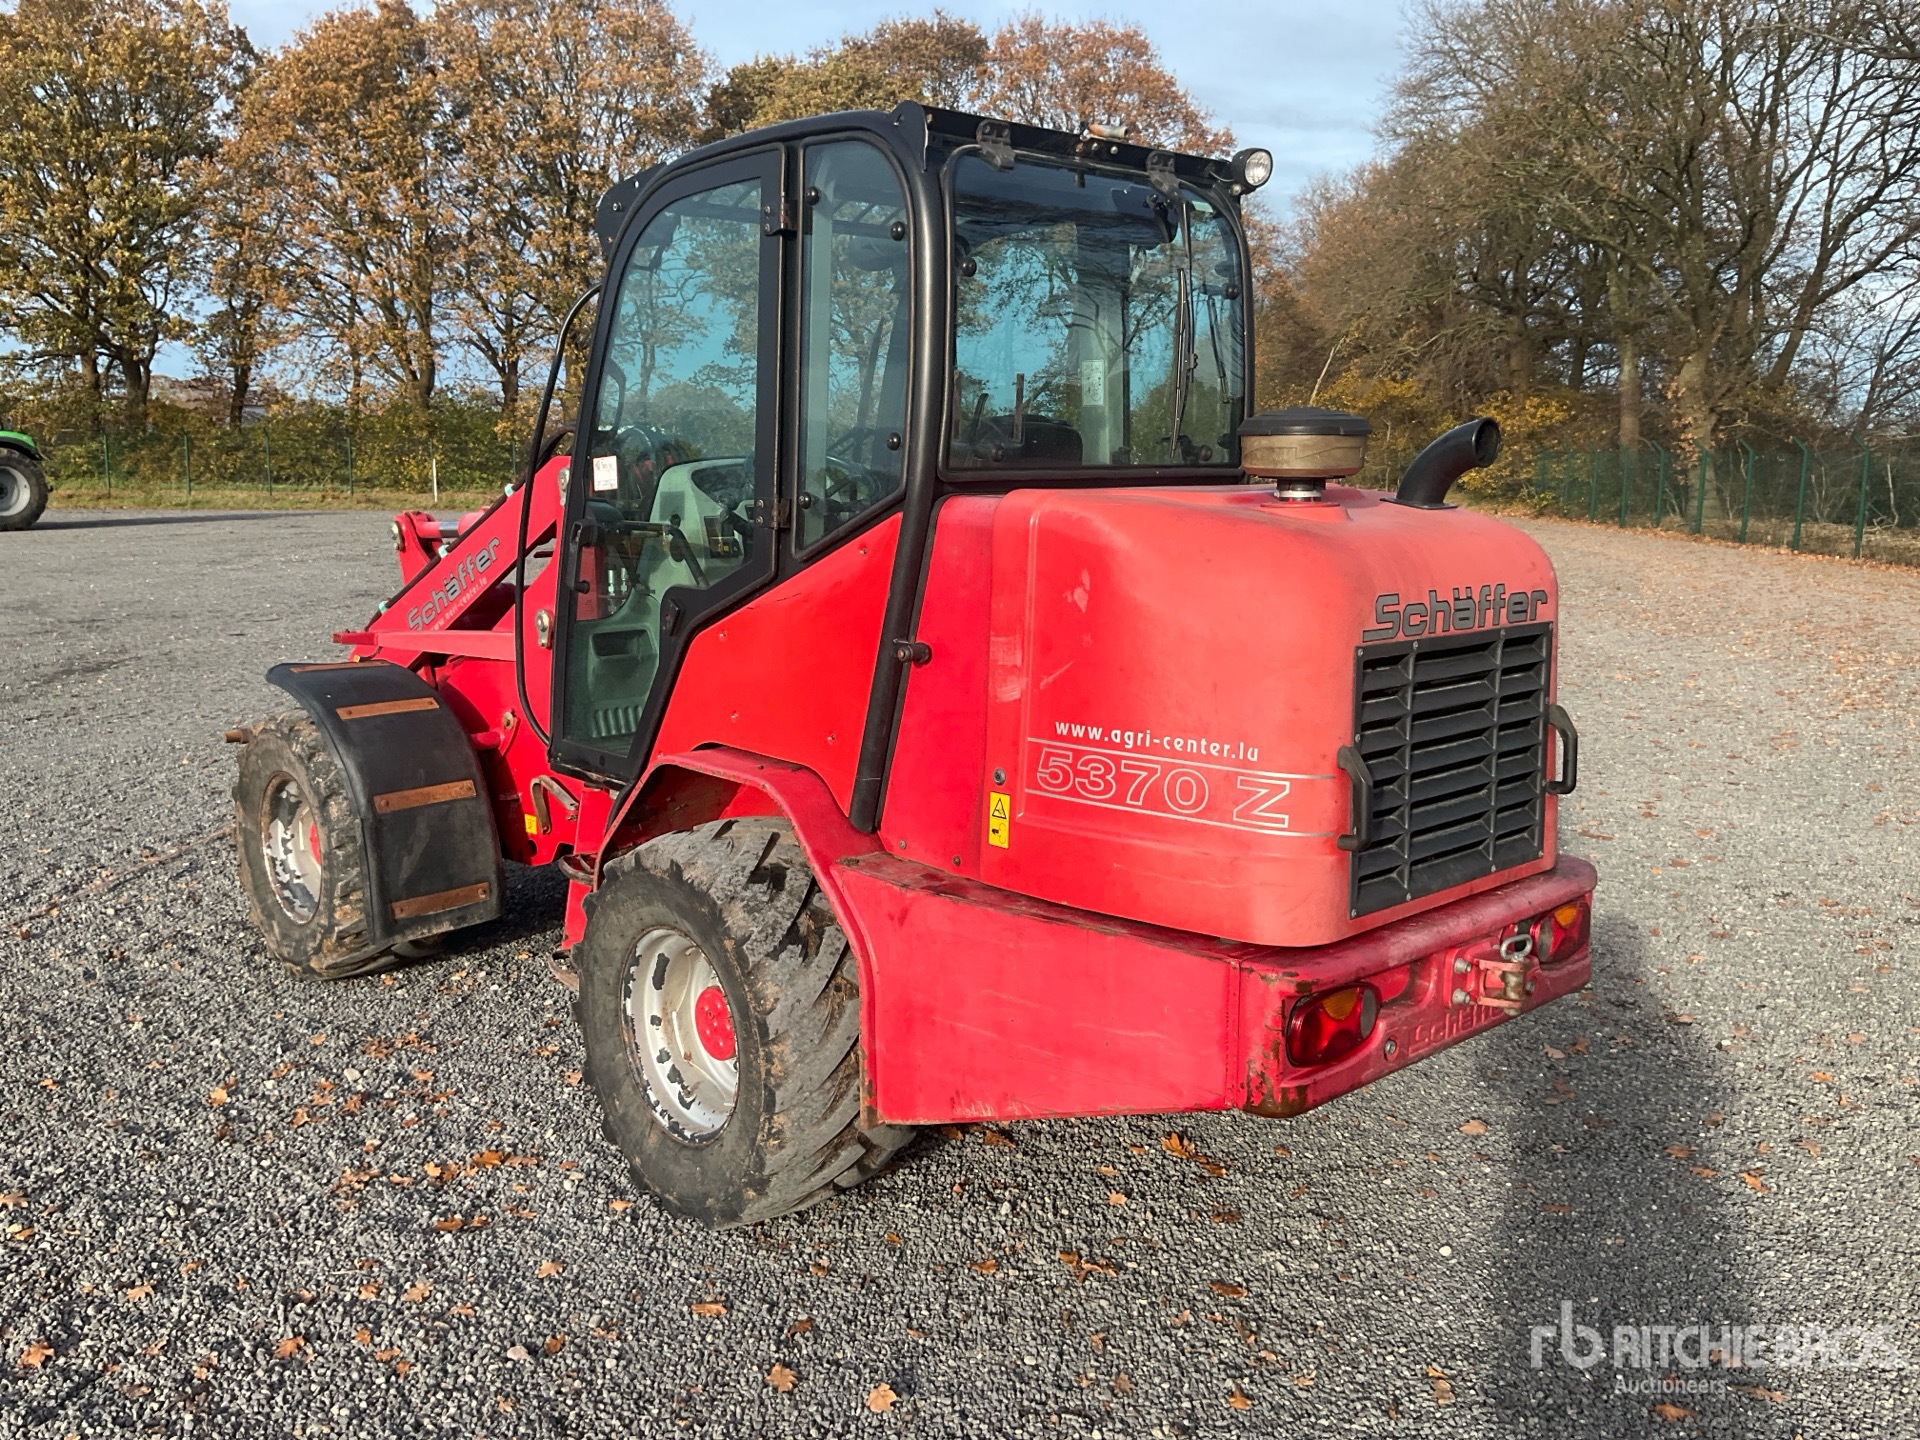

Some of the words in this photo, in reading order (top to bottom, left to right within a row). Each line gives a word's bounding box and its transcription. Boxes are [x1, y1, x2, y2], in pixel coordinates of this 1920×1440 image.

[1362, 583, 1548, 643] Schäffer
[1055, 721, 1259, 762] www.agri-center.lu
[1036, 747, 1209, 813] 5370
[1232, 775, 1291, 828] Z
